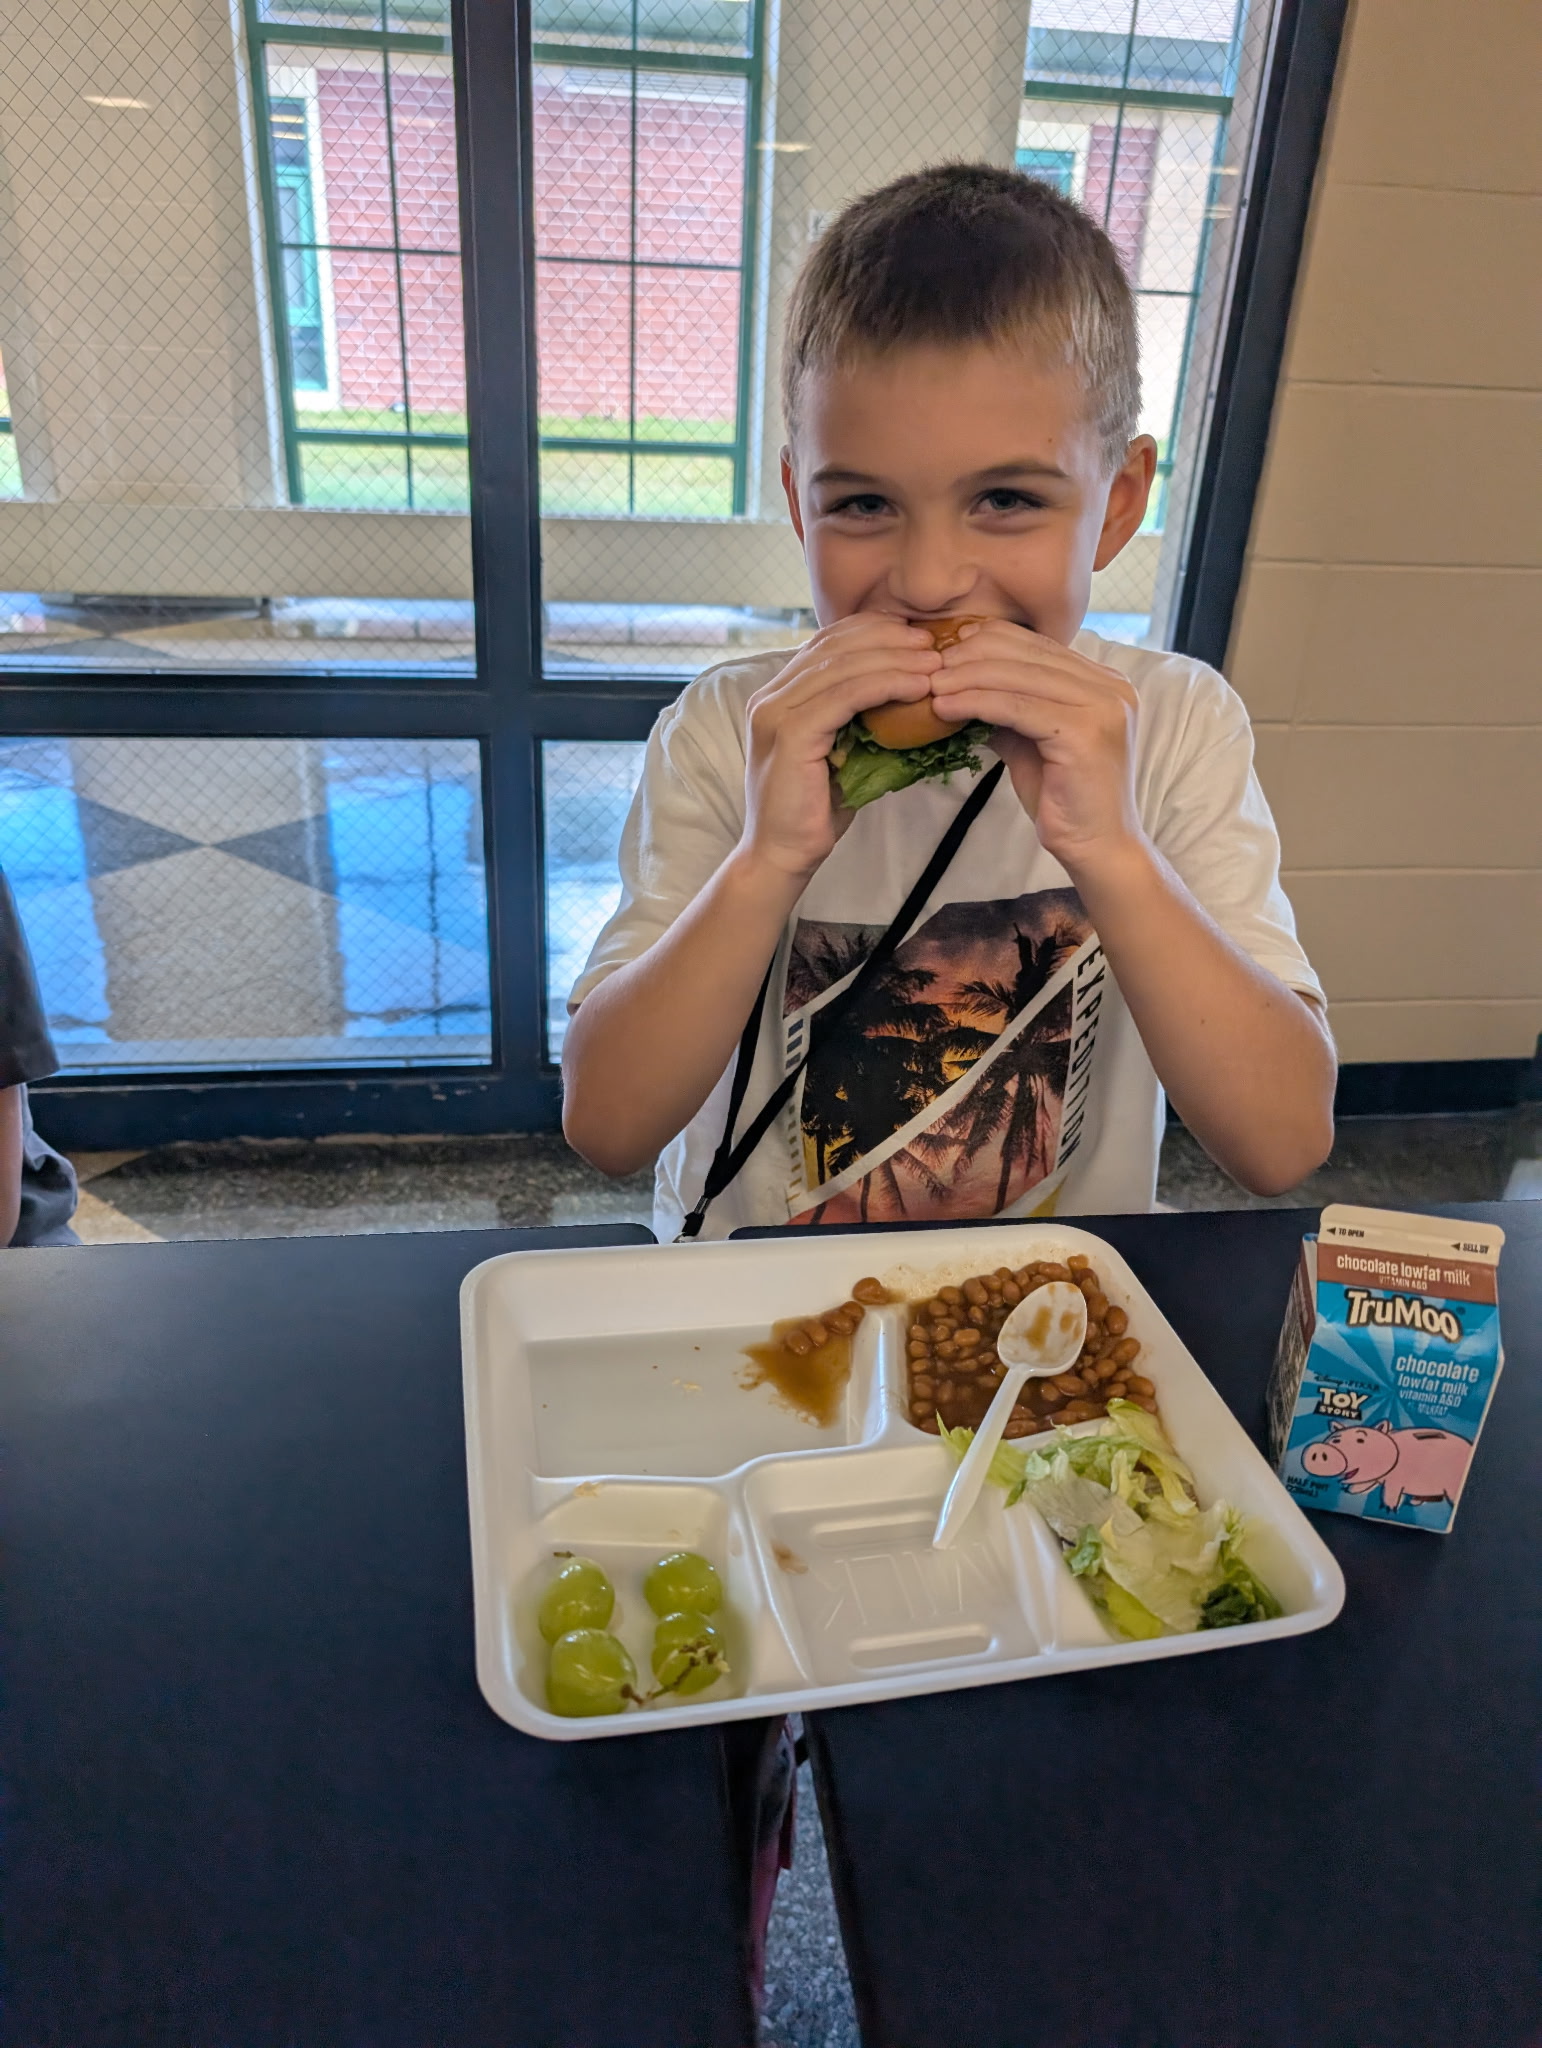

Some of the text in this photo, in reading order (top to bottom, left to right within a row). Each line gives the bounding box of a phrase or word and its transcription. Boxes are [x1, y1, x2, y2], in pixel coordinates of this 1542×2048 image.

[1056, 945, 1106, 1170] EXPEDITION
[1338, 1227, 1365, 1238] TO OPEN
[1336, 1254, 1471, 1287] chocolate lowfat milk
[1379, 1276, 1410, 1288] VITAMIN
[1346, 1290, 1463, 1342] TruMoo
[1396, 1354, 1479, 1383] chocolate
[1398, 1374, 1469, 1397] lowfat milk
[1319, 1387, 1369, 1409] TOY
[1399, 1389, 1462, 1408] vitamin A&D
[1319, 1405, 1359, 1418] STORY
